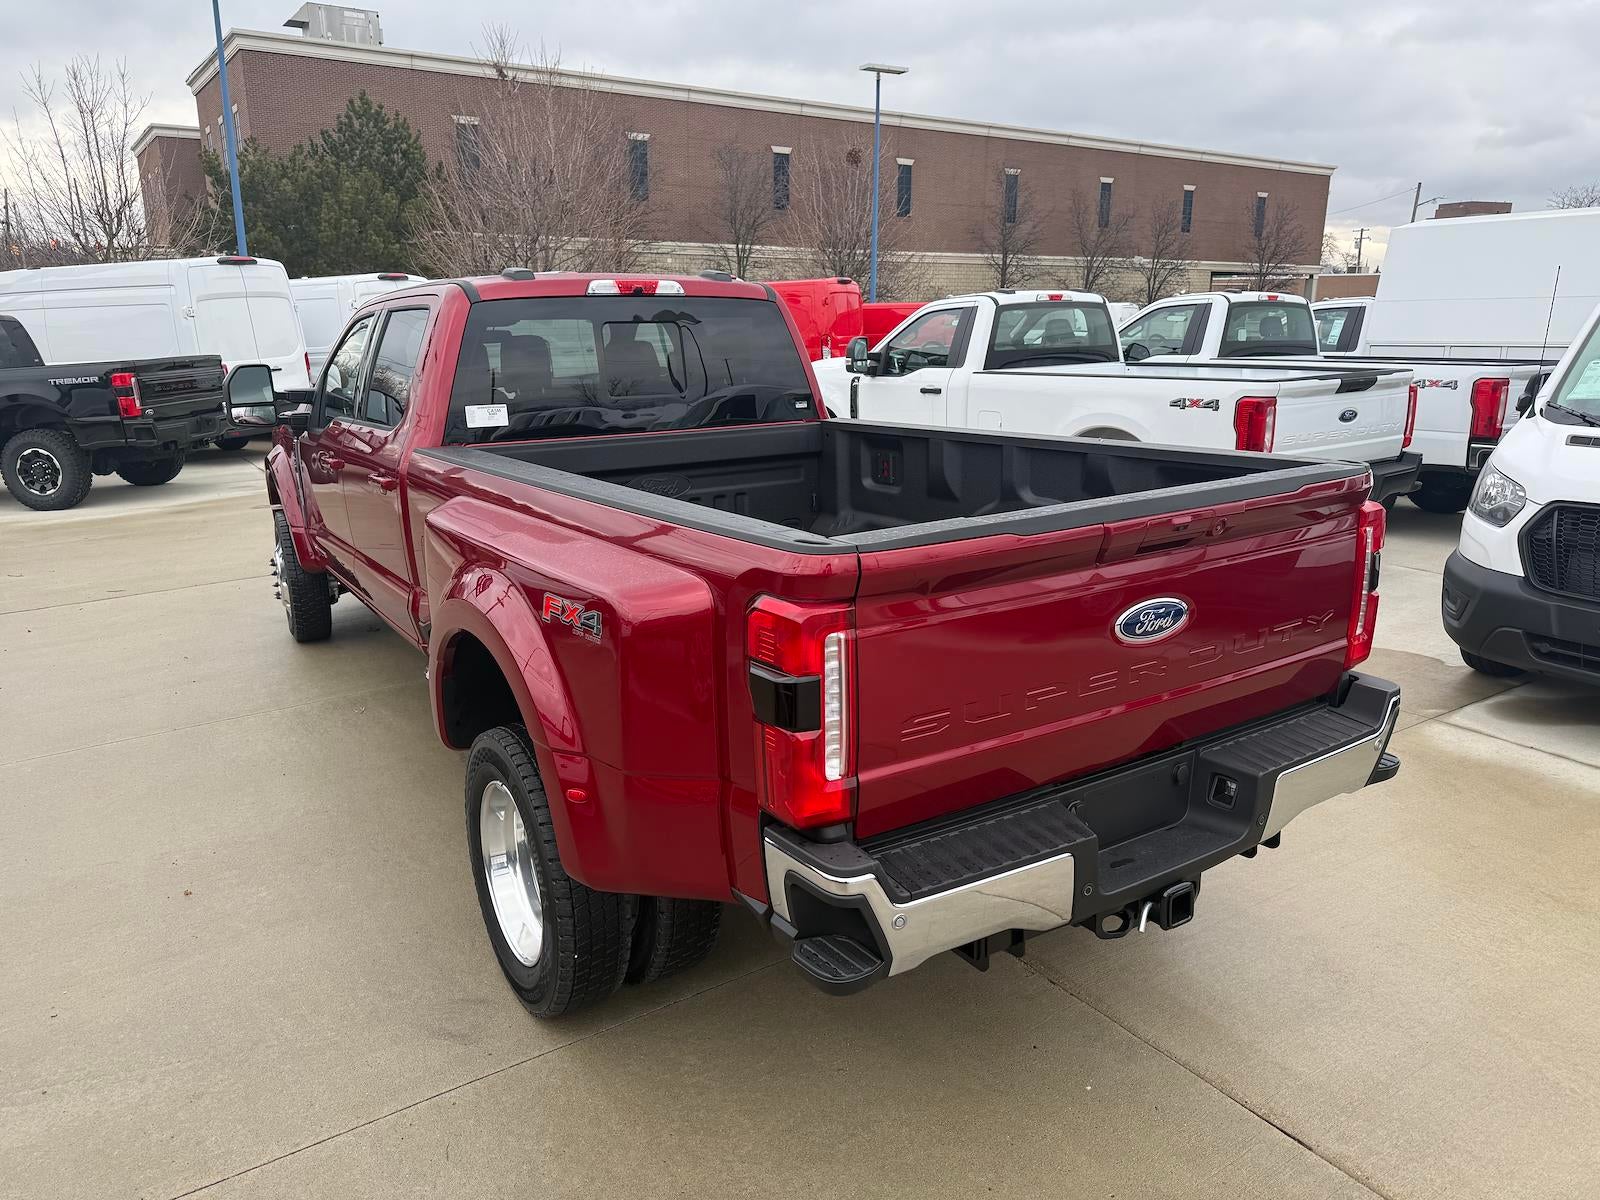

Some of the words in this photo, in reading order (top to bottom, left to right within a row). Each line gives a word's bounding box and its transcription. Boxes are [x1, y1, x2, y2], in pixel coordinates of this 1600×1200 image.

[48, 376, 99, 385] TREMOR
[1280, 428, 1353, 446] SUPER
[1358, 421, 1401, 437] DUTY
[541, 591, 602, 639] FX4
[1135, 607, 1175, 635] Ford
[900, 659, 1168, 742] SUPER
[1187, 608, 1335, 669] DUTY
